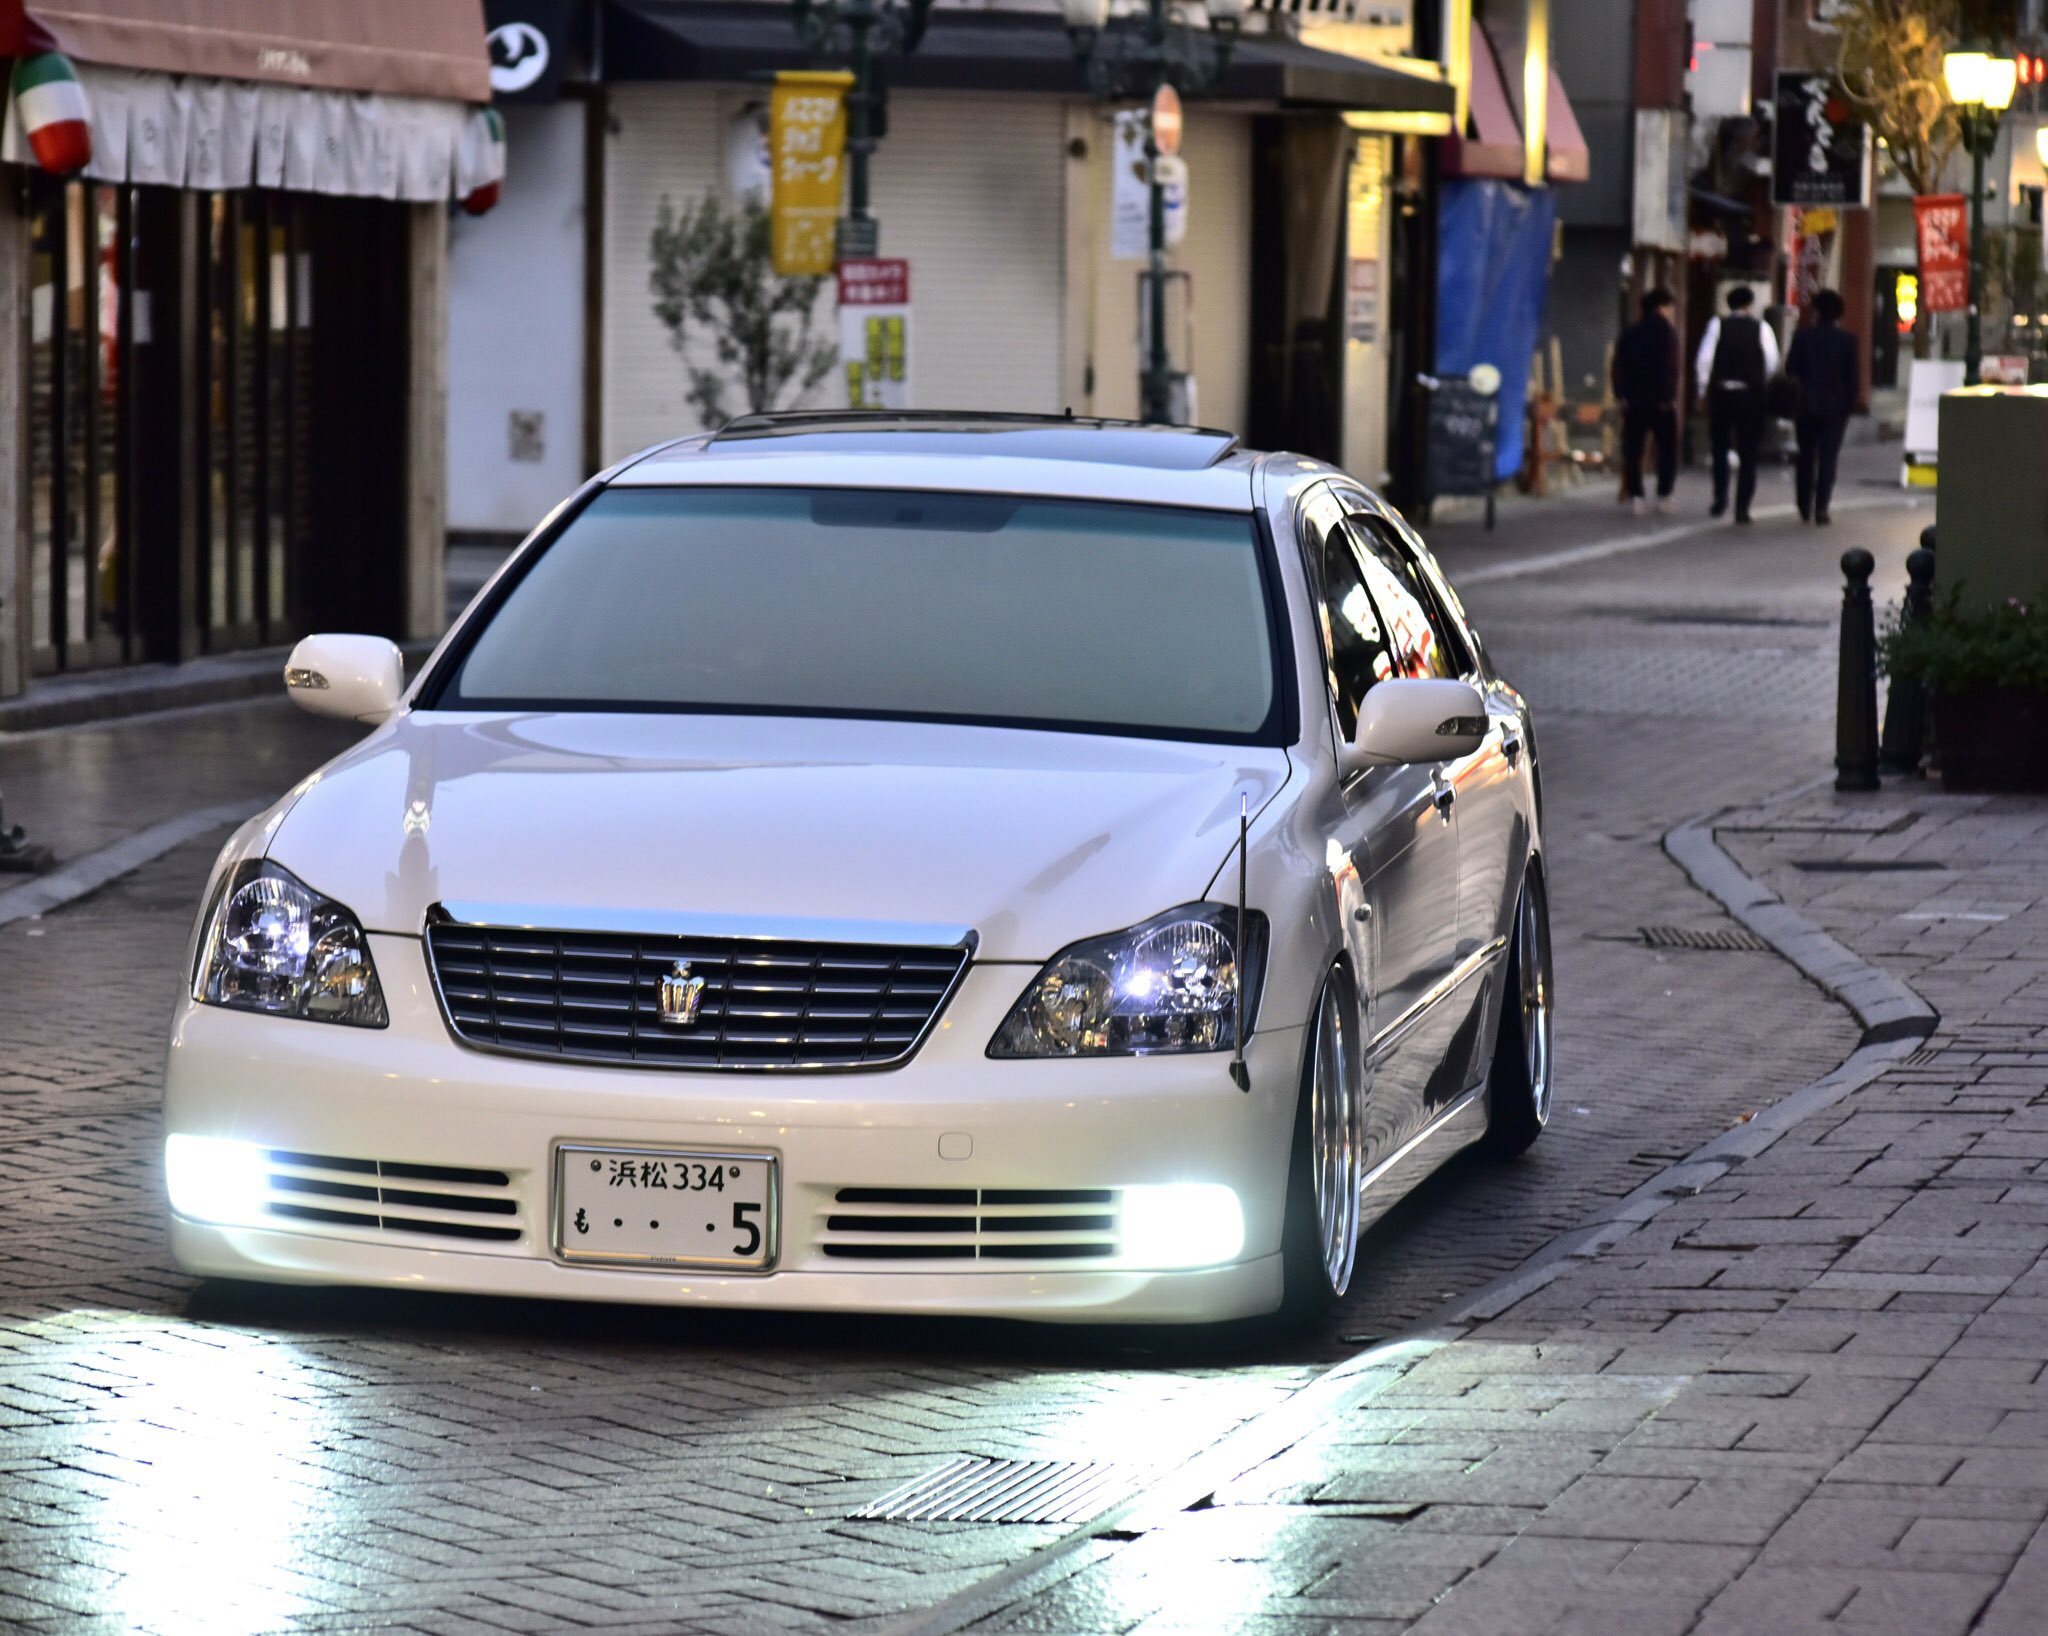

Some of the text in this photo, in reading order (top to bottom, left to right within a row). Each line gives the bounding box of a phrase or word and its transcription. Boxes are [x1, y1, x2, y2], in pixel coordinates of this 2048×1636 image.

[609, 1158, 725, 1192] 浜松334
[574, 1202, 761, 1256] も 5
